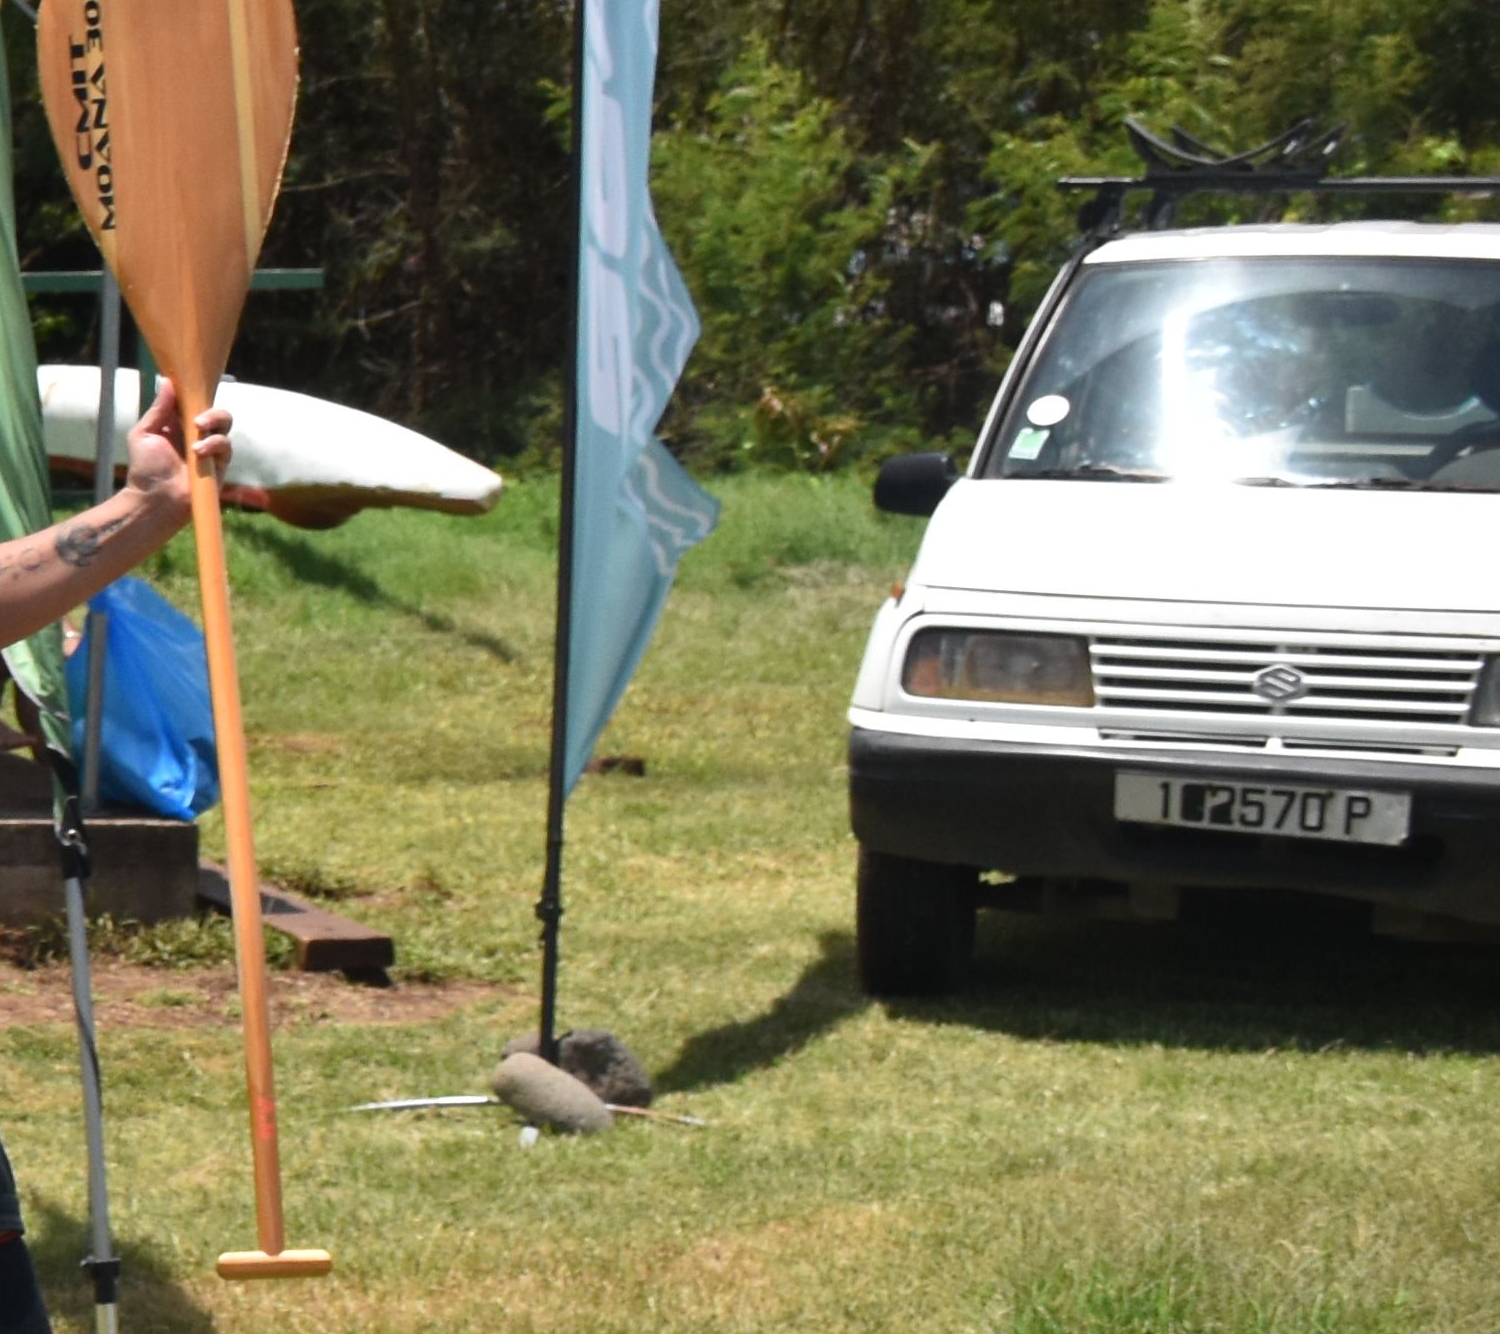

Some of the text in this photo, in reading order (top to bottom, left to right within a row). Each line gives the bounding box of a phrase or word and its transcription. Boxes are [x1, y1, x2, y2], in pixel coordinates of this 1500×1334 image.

[69, 35, 92, 170] CMIT
[89, 63, 116, 230] MOANA
[1160, 781, 1372, 836] 12570 P
